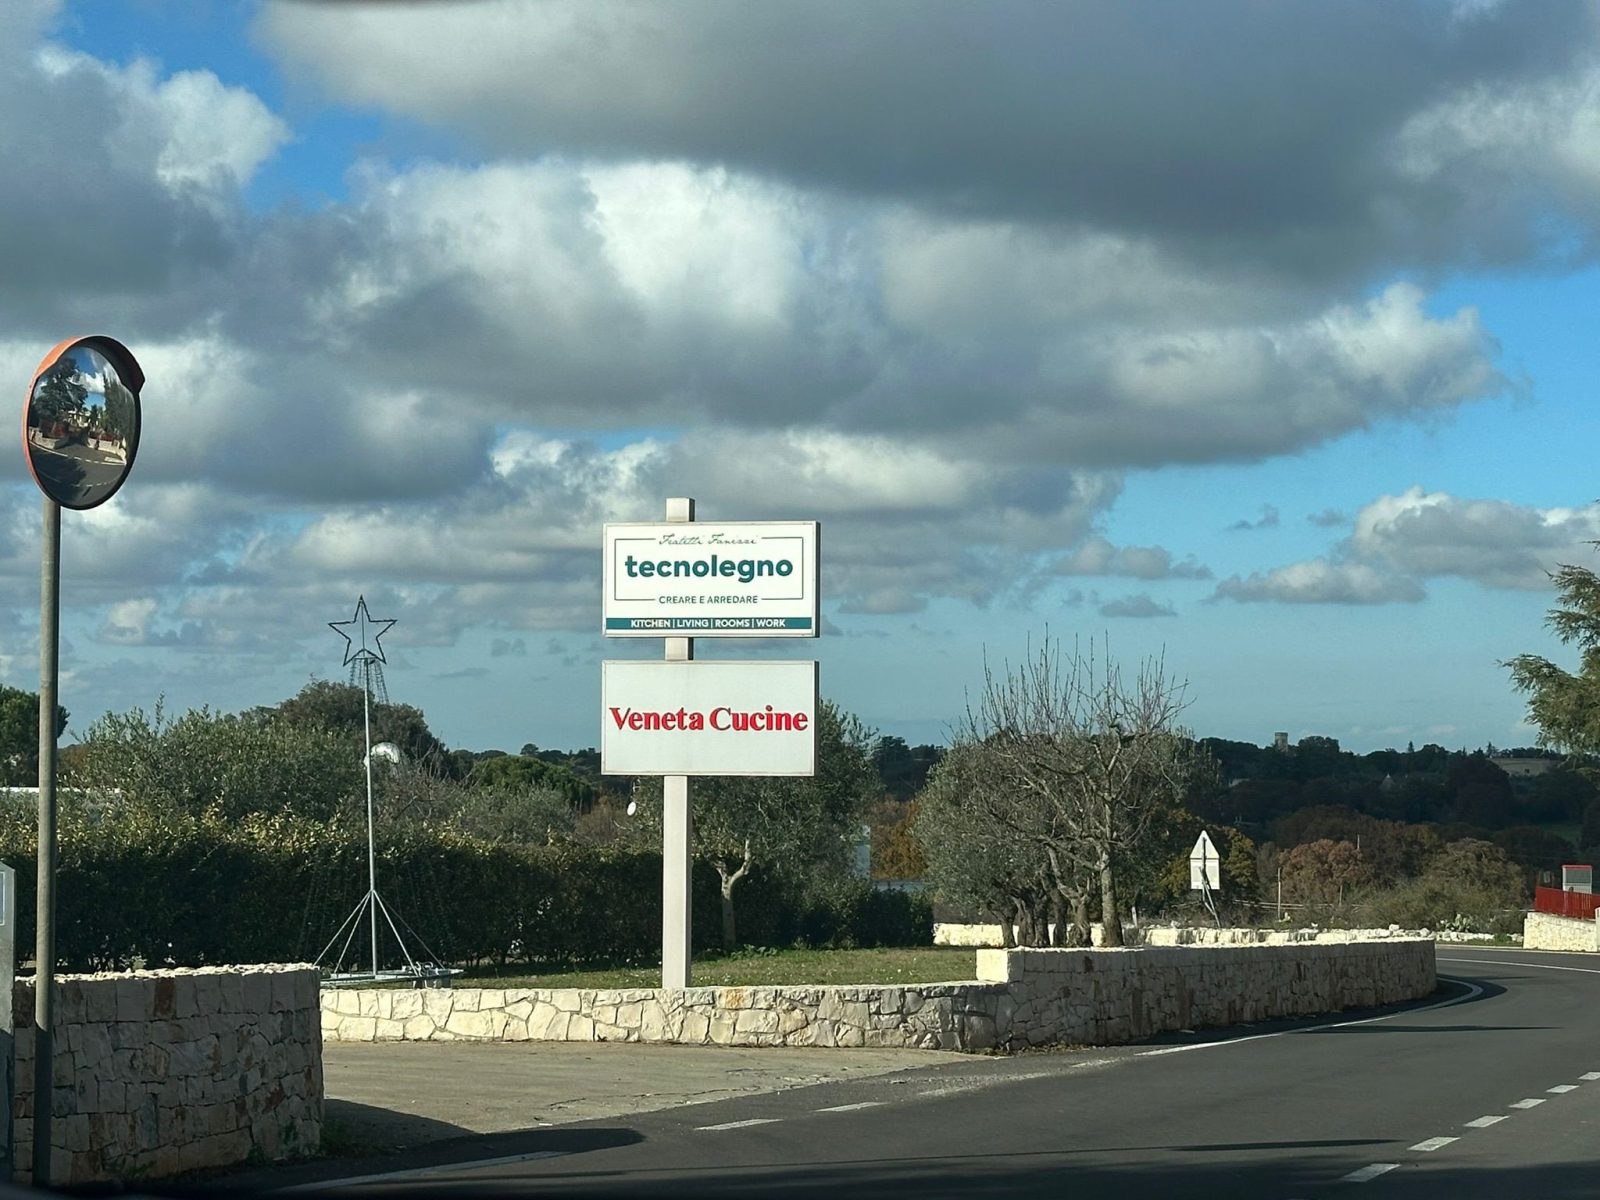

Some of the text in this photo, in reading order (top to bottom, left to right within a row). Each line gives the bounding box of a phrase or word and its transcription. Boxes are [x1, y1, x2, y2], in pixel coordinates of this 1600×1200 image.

[625, 555, 793, 583] tecnolegno
[659, 595, 758, 604] CREARE E ARREDARE
[631, 618, 786, 628] KITCHEN LIVING ROOMS WORK
[609, 705, 808, 731] Veneta Cucine
